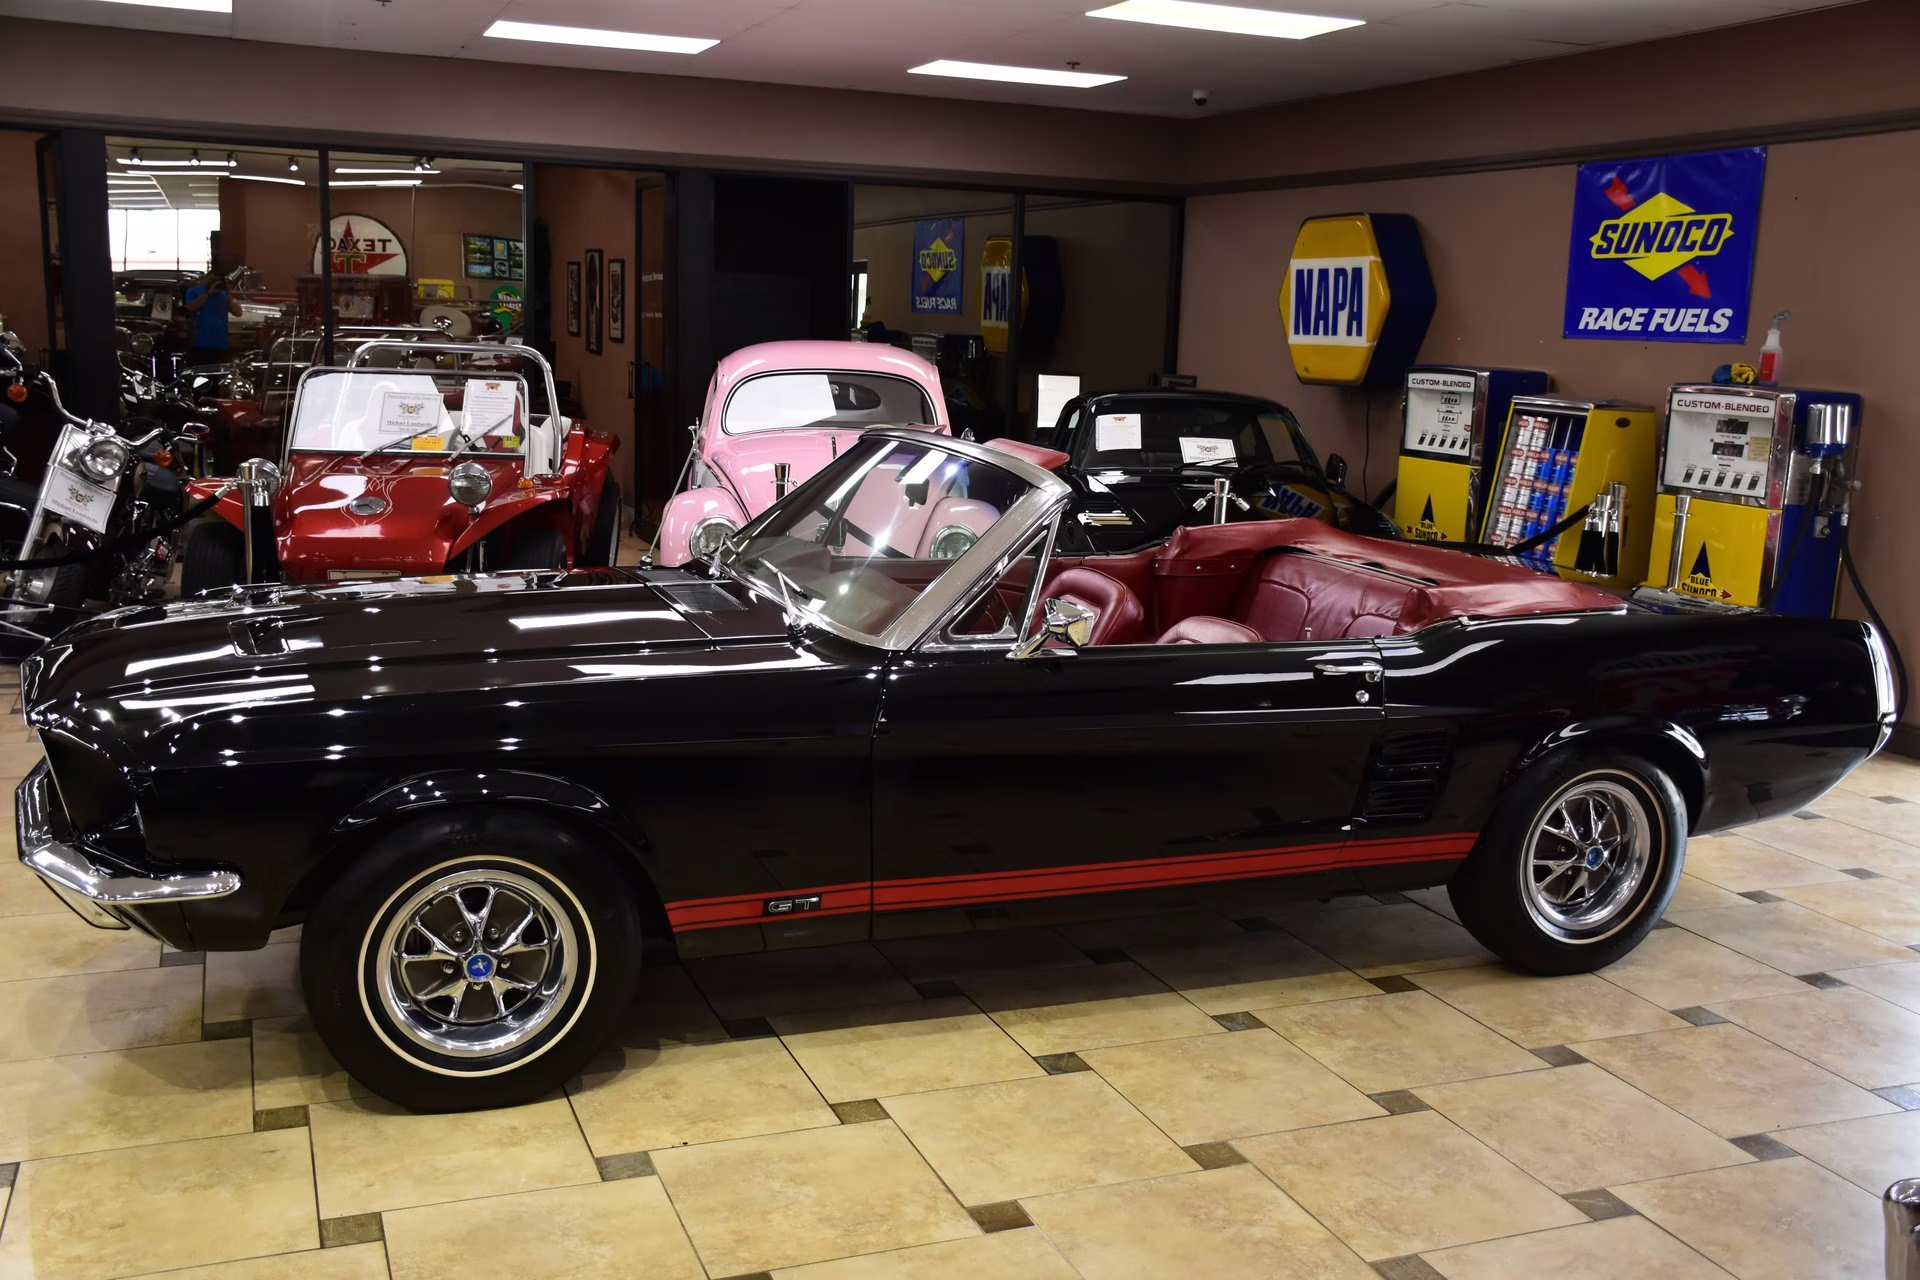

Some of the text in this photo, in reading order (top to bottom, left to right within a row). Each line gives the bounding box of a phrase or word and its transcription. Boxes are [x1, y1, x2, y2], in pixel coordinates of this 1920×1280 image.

[1595, 218, 1727, 254] SUNOCO
[1294, 267, 1363, 336] NAPA
[1578, 307, 1732, 333] RACE FUELS
[1411, 378, 1471, 388] CUSTOM-BLENDED
[1677, 399, 1770, 413] CUSTOM-BLENDED
[1690, 576, 1709, 586] BLUE
[768, 897, 819, 913] GT
